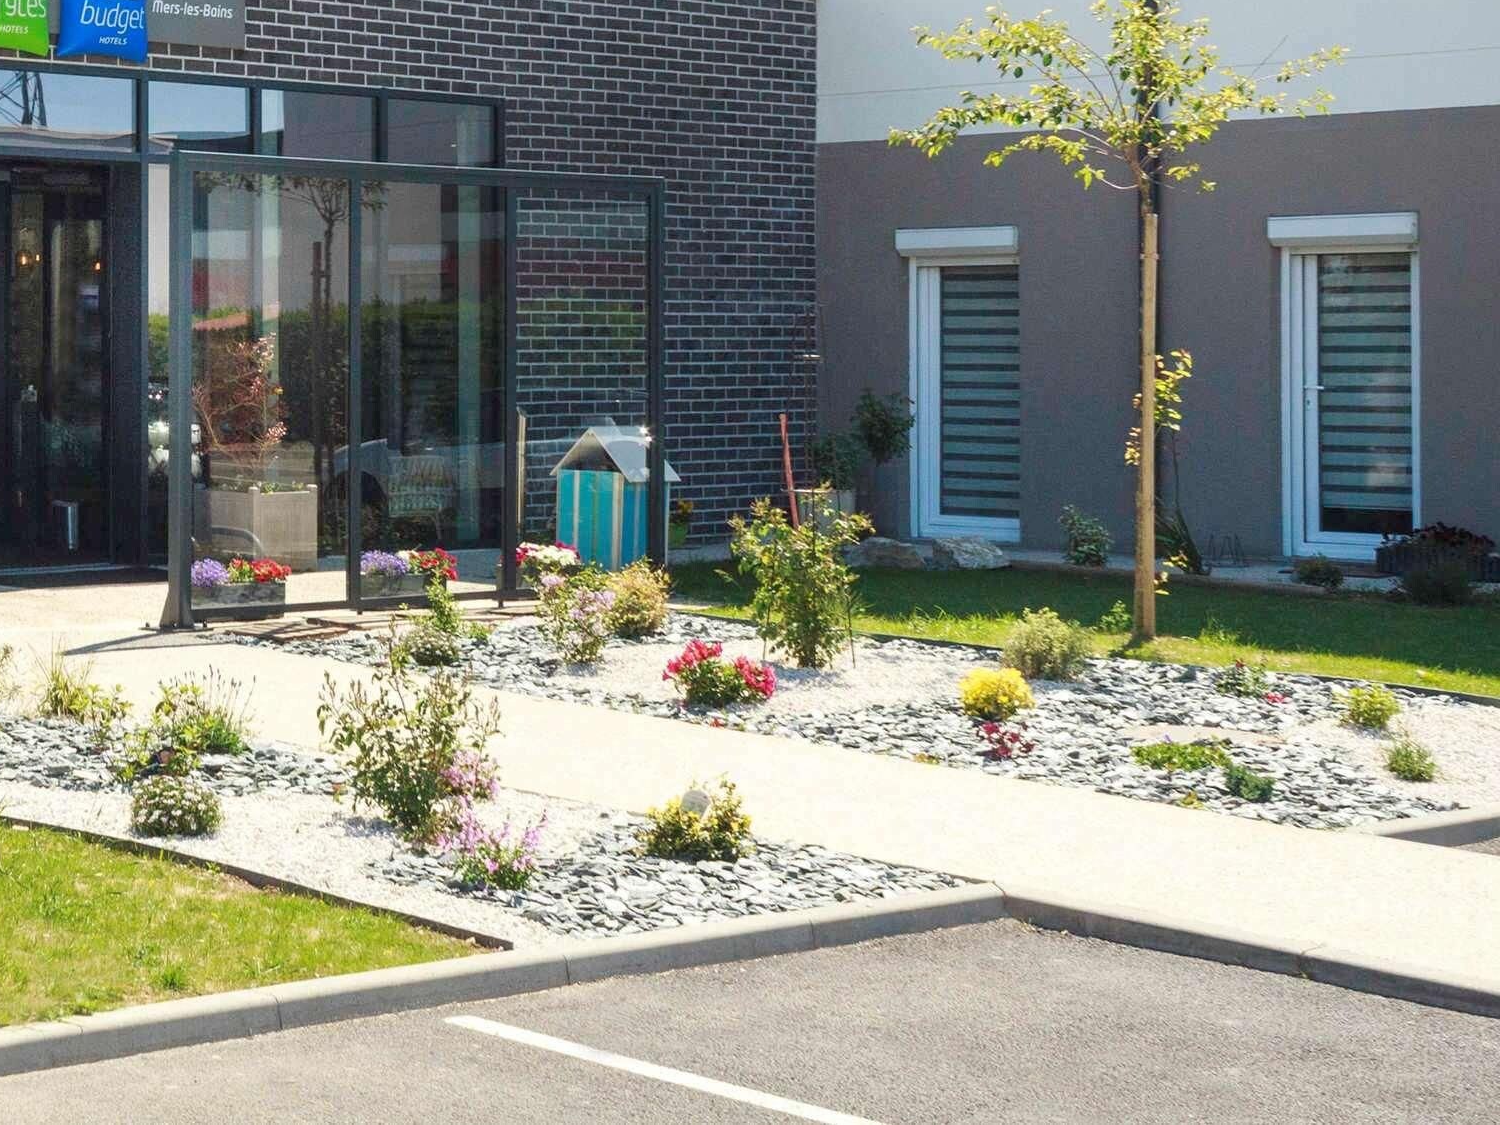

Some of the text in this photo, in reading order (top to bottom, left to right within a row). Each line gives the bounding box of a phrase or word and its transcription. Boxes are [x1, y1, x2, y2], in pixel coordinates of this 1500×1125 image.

[152, 0, 233, 19] Mers-les-Bains
[80, 0, 145, 34] budget
[0, 25, 29, 34] HOTELS
[99, 36, 128, 45] HOTELS
